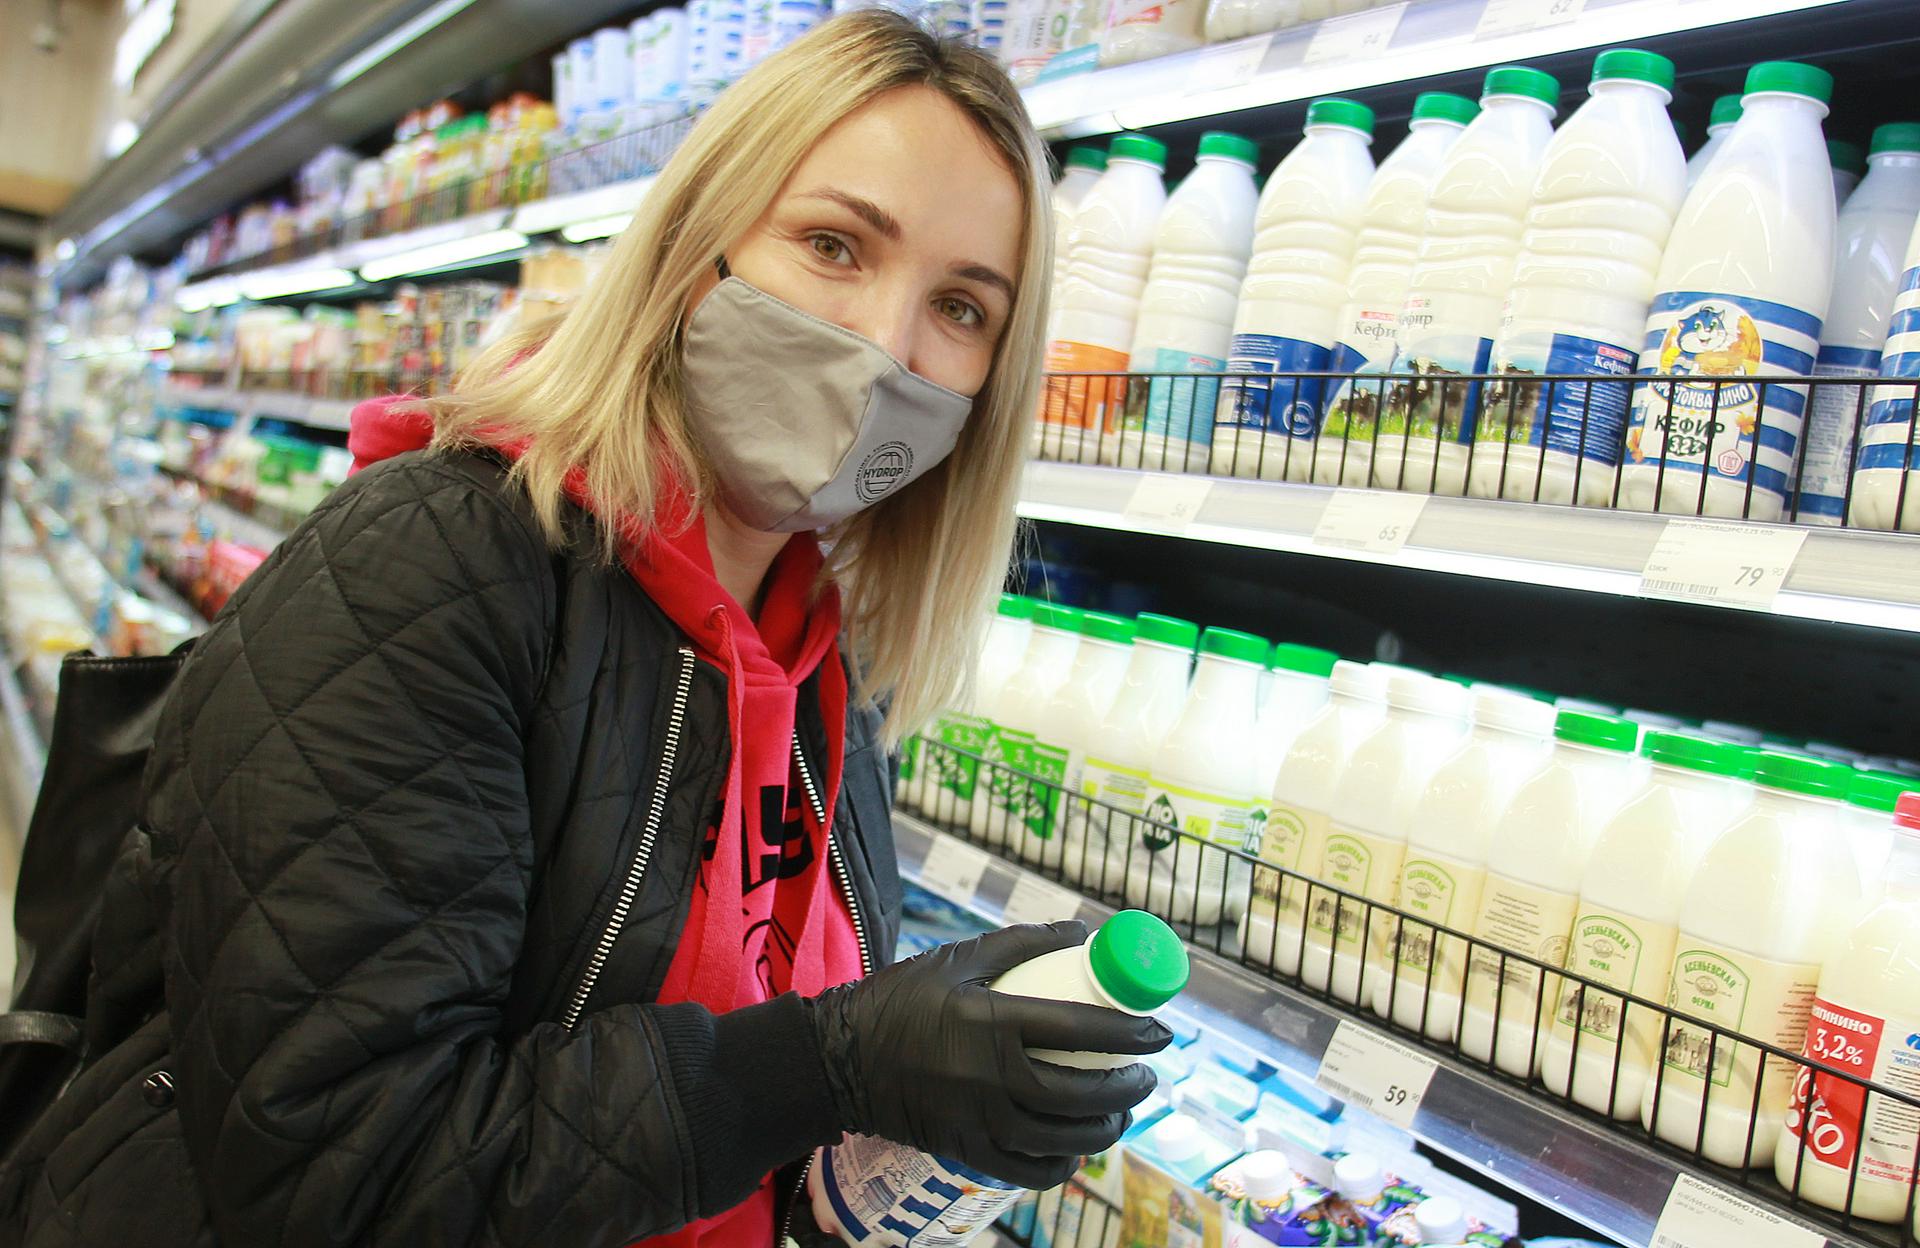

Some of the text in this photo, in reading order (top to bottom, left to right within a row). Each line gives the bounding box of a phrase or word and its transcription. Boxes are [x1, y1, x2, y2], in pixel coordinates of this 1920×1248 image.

[1353, 321, 1400, 340] Кефи
[863, 467, 904, 479] HYDROP
[1378, 525, 1400, 542] 65
[1734, 566, 1765, 587] 79
[1812, 1027, 1864, 1066] 3,2%
[1385, 1085, 1407, 1106] 59
